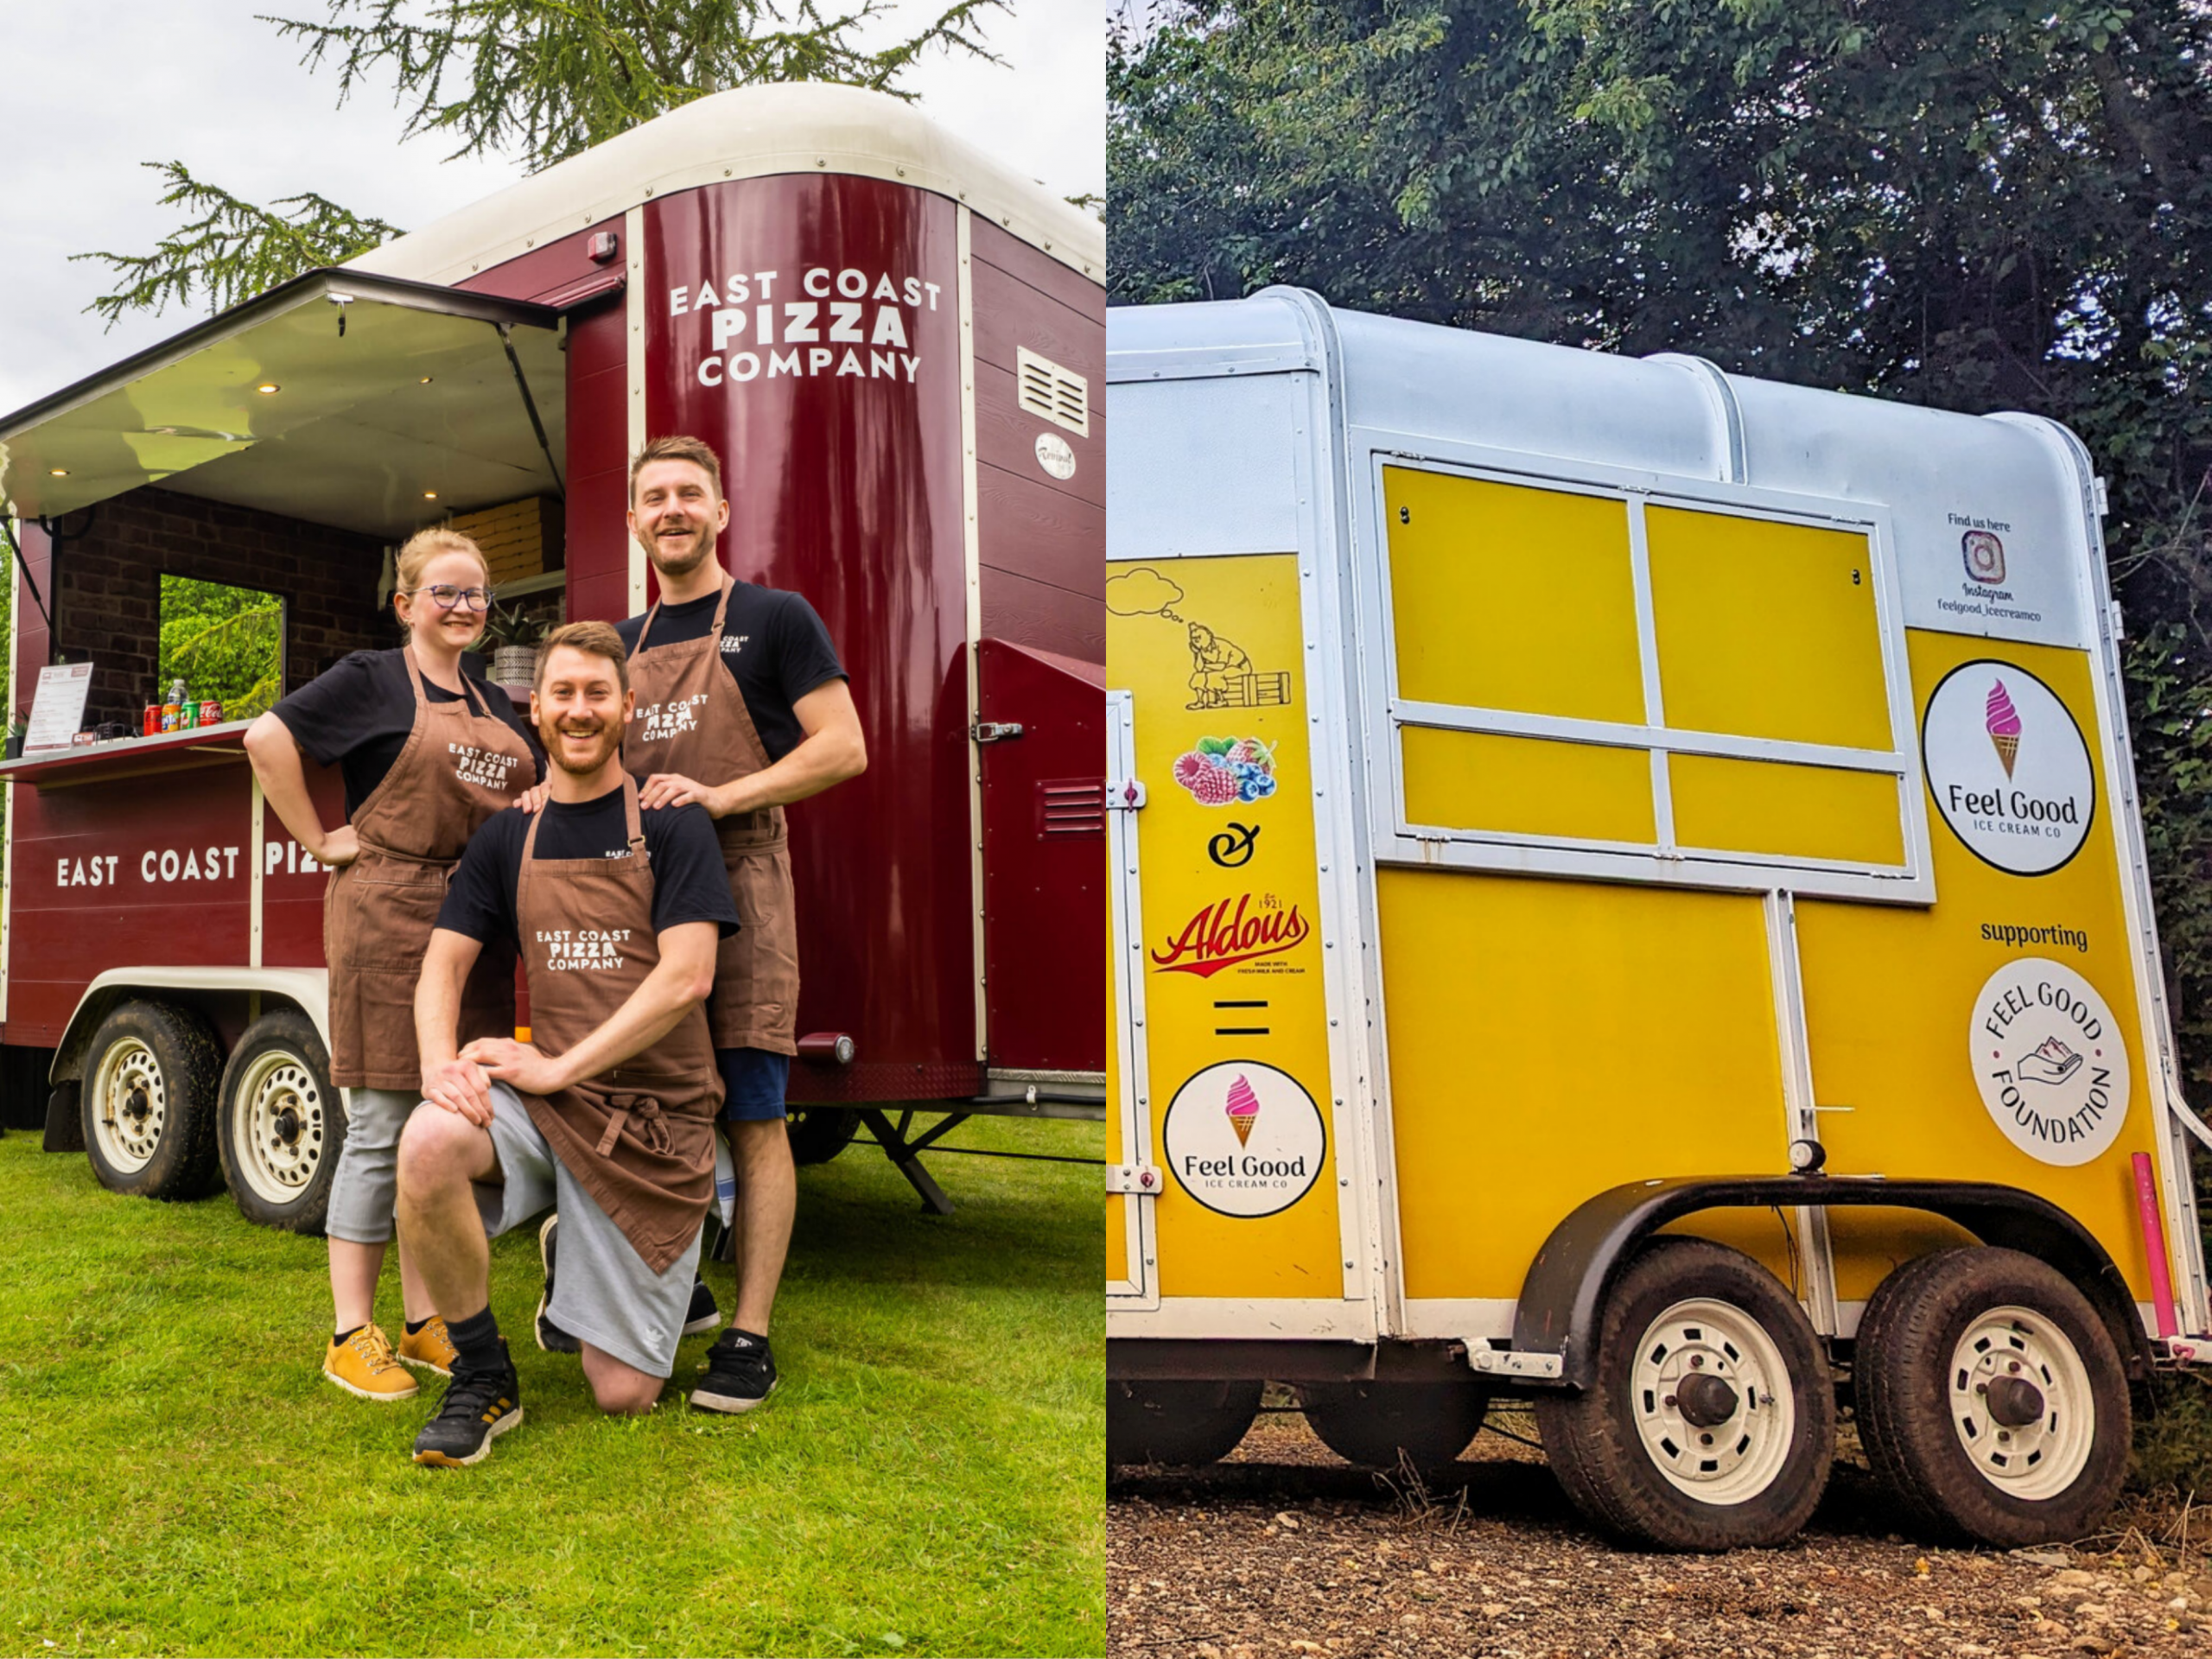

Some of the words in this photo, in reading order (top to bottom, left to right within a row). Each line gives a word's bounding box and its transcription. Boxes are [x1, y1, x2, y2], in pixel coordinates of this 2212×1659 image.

[671, 270, 777, 316] EAST
[804, 268, 941, 311] COAST
[712, 302, 908, 352] PIZZA
[697, 346, 921, 386] COMPANY
[1948, 512, 1972, 528] Find
[1973, 518, 1986, 529] us
[1987, 518, 2011, 532] here
[1961, 582, 2014, 604] Instagram
[642, 720, 697, 741] COMPNY
[448, 742, 480, 759] EAST
[484, 752, 518, 768] COAST
[459, 756, 506, 780] PIZZA
[455, 770, 508, 791] COMPANY
[1948, 785, 2005, 817] Feel
[2010, 791, 2079, 824] Good
[1974, 819, 1994, 831] ICE
[1999, 822, 2040, 836] CREAM
[2045, 827, 2061, 838] CO
[57, 855, 118, 887] EAST
[141, 846, 239, 882] COAST
[264, 841, 335, 875] PIZ
[1258, 899, 1283, 909] 1921
[536, 930, 571, 943] EAST
[578, 929, 631, 942] COAST
[1152, 893, 1301, 964] Aldous
[1981, 923, 2088, 952] supporting
[550, 942, 617, 958] PIZZA
[547, 957, 623, 970] COMPANY
[1986, 985, 2034, 1039] FEEL
[2037, 981, 2102, 1040] GOOD
[1992, 1066, 2111, 1144] FOUNDATION
[1185, 1155, 1236, 1177] Feel
[1242, 1155, 1306, 1177] Good
[1205, 1179, 1224, 1188] ICE
[1229, 1179, 1268, 1188] CREAM
[1273, 1179, 1287, 1188] CO
